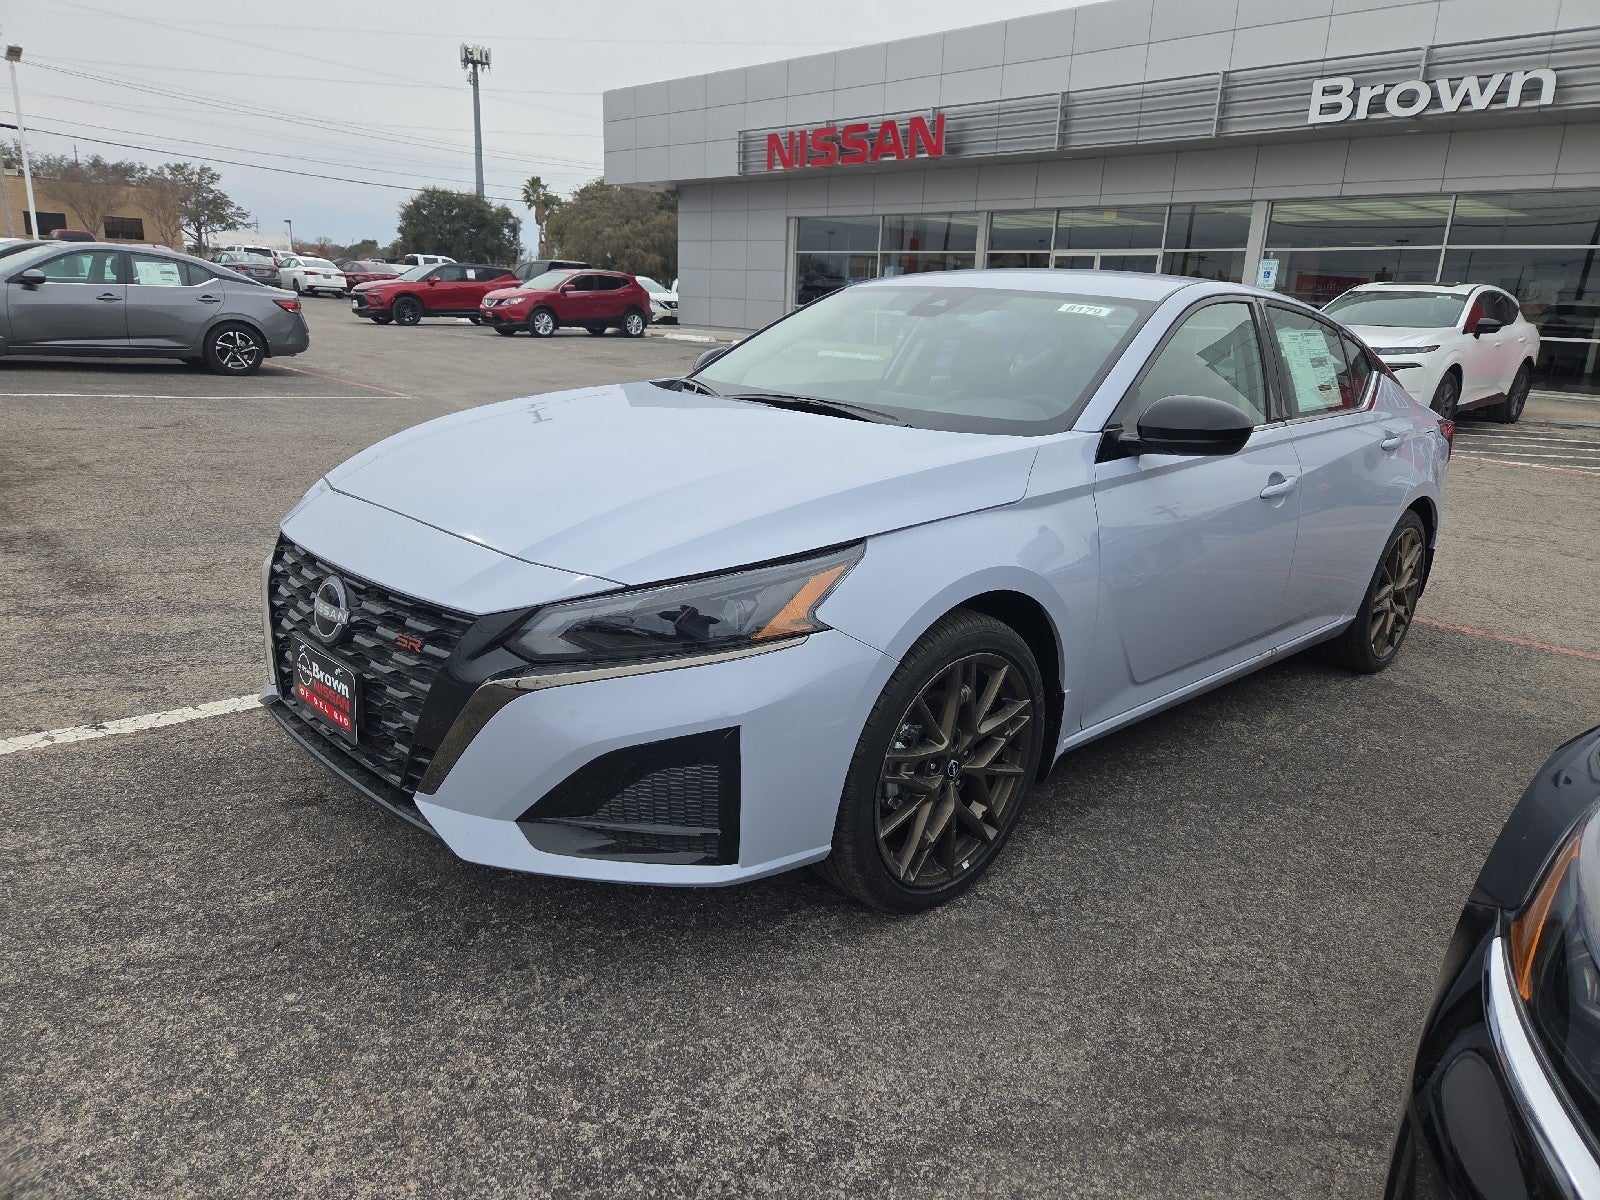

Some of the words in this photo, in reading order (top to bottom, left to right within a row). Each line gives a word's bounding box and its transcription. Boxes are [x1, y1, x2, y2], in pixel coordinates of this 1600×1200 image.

[1307, 68, 1557, 124] Brown
[767, 113, 946, 171] NISSAN
[396, 632, 422, 652] SR
[300, 688, 309, 698] OF
[312, 661, 350, 698] Brown
[313, 679, 350, 712] NISSAN
